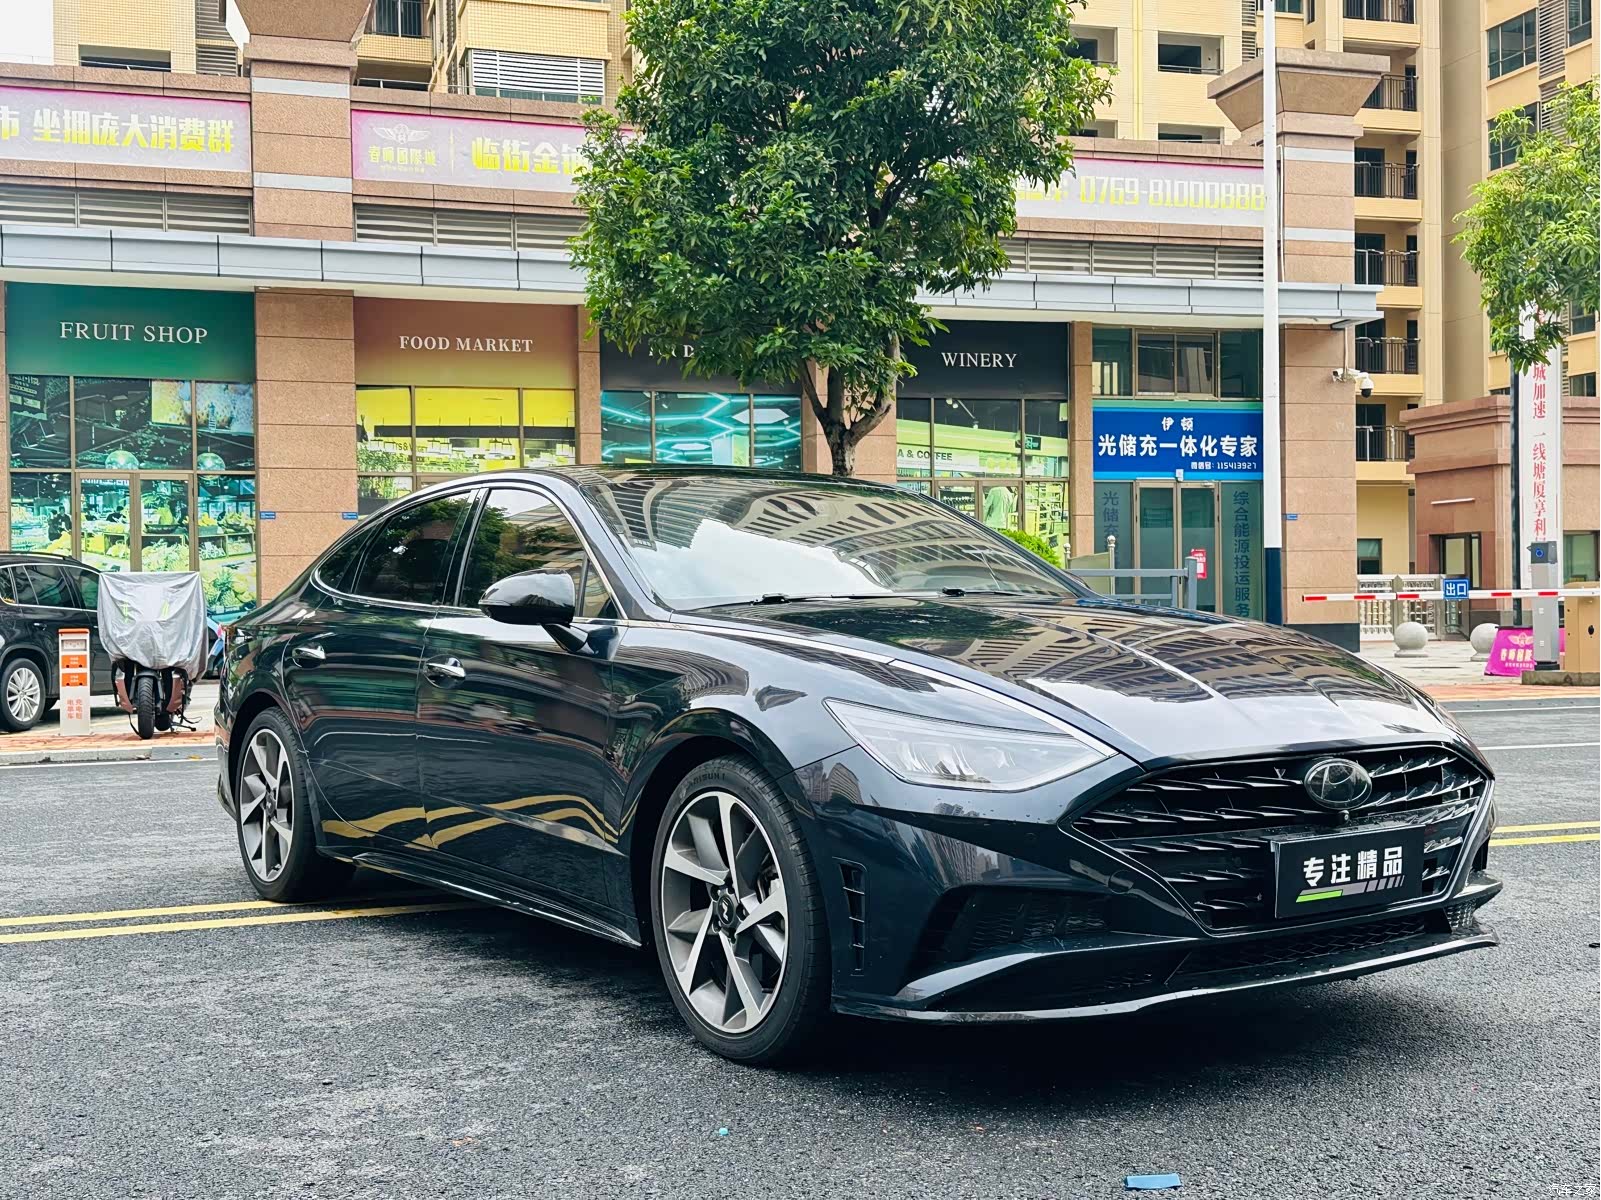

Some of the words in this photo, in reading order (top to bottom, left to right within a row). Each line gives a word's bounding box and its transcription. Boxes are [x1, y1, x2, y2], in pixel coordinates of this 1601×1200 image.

[33, 108, 234, 153] 坐拥庞大消费群
[59, 322, 135, 341] FRUIT
[143, 325, 208, 344] SHOP
[399, 336, 450, 350] FOOD
[456, 337, 533, 353] MARKET
[941, 352, 1017, 368] WINERY
[1161, 417, 1194, 431] 伊顿
[1098, 433, 1258, 458] 光储充一体化专家
[1216, 461, 1257, 470] 115413927
[1532, 432, 1547, 542] 一线塘厦享利
[1233, 490, 1250, 618] 综合能源投运服务
[1446, 582, 1467, 596] 出口
[1303, 846, 1403, 887] 专注精品
